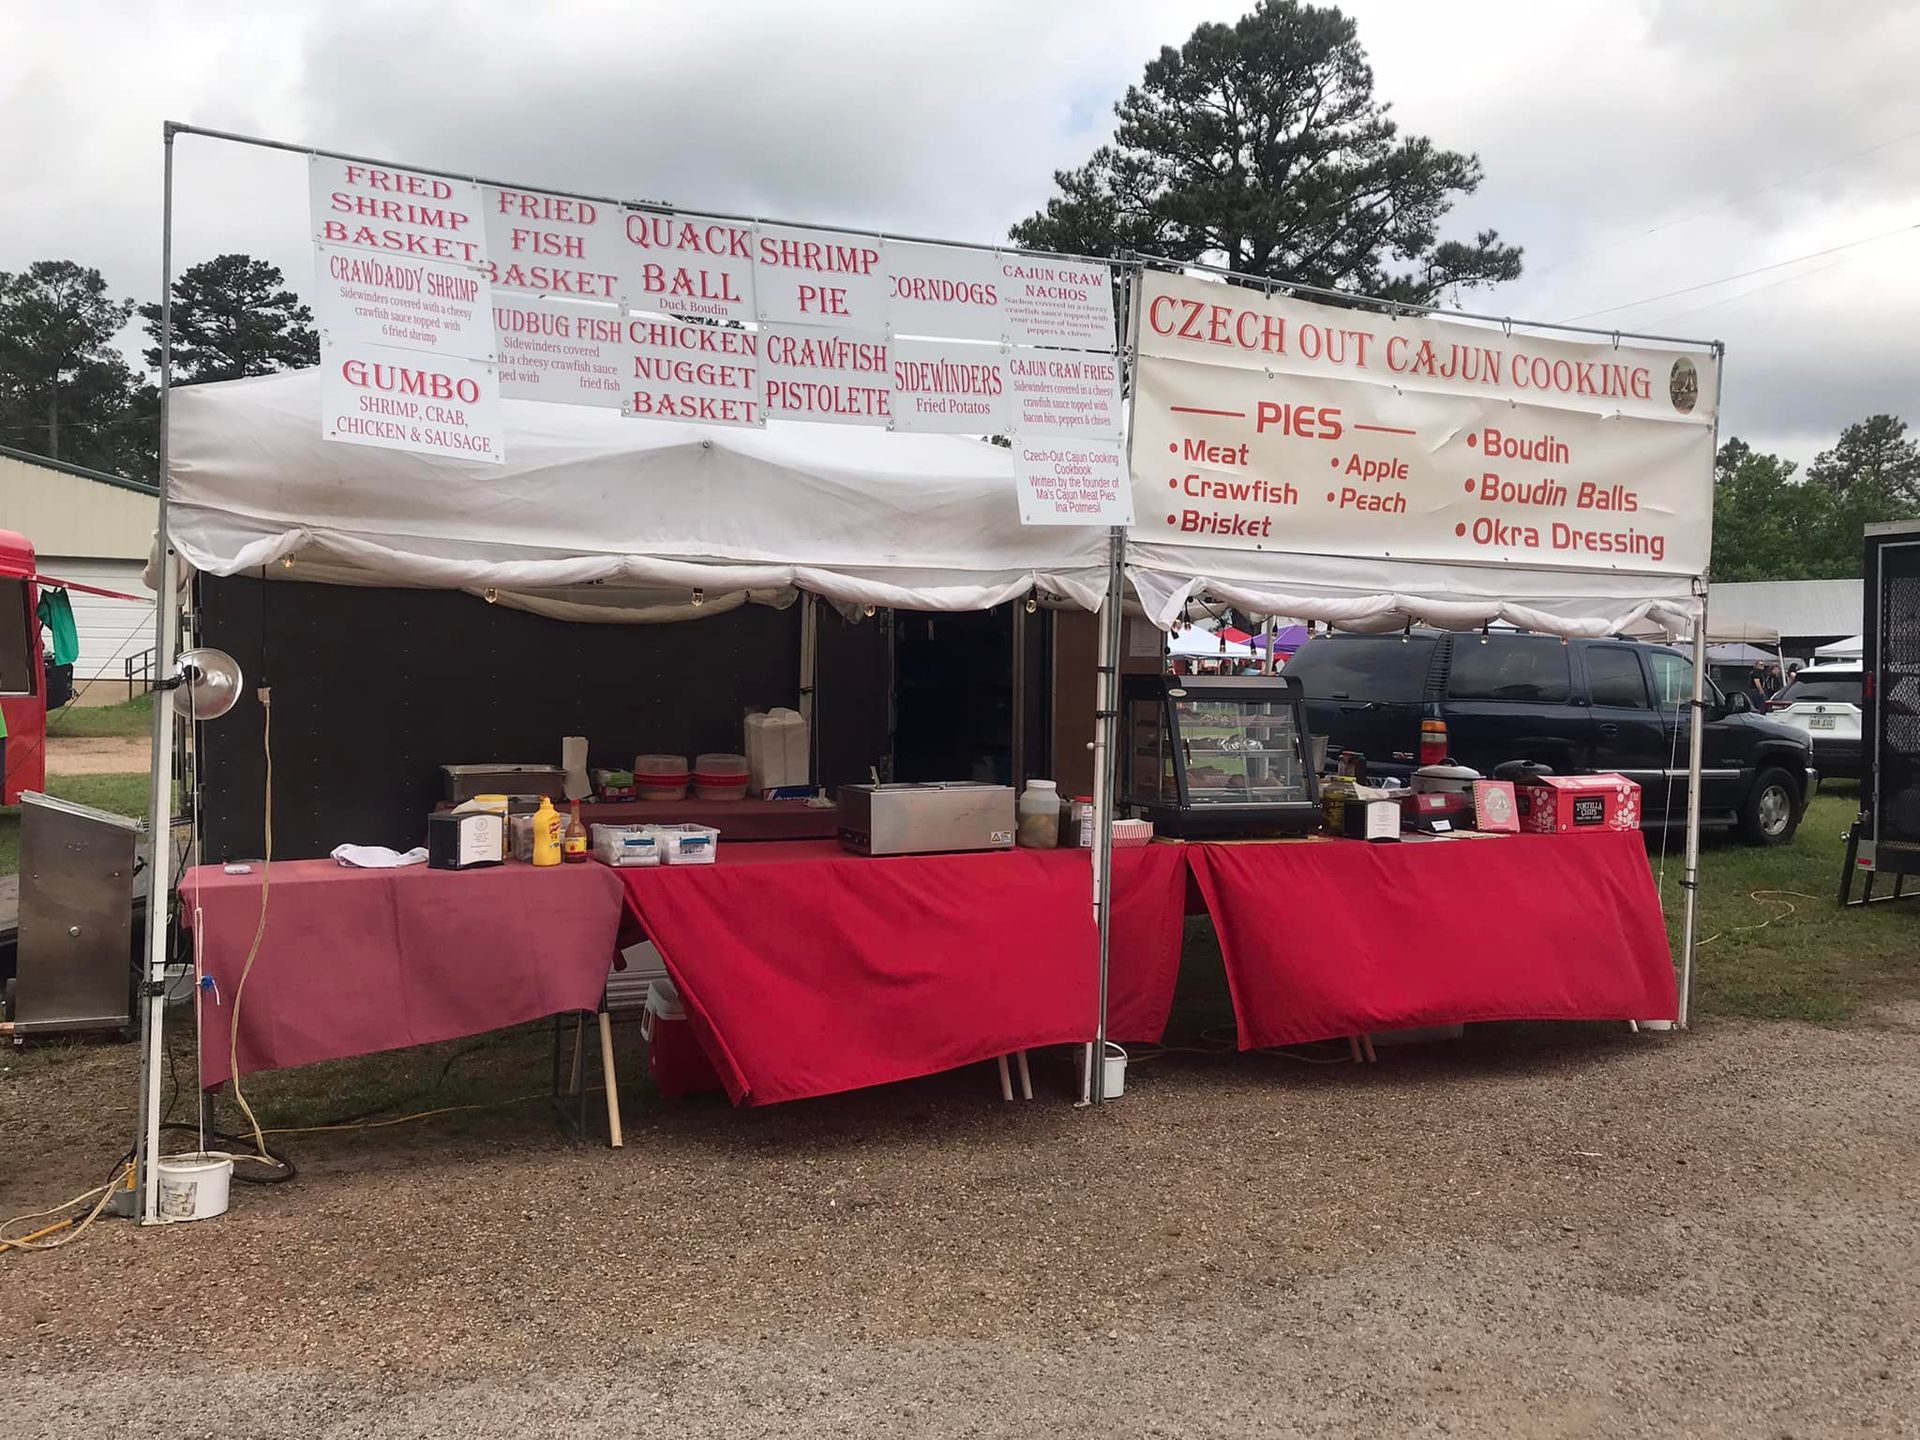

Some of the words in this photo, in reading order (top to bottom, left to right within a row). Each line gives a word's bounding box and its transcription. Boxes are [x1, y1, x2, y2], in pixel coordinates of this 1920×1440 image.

[346, 165, 453, 200] FRIED
[331, 192, 469, 230] SHRIMP
[498, 191, 596, 225] FRIED
[323, 221, 479, 262] BASKET
[511, 228, 585, 259] FISH
[626, 214, 752, 260] QUACK
[760, 237, 879, 276] SHRIMP
[330, 255, 423, 292] CRAWDADDY
[428, 272, 478, 302] SHRIMP
[642, 264, 742, 302] BALL
[1003, 265, 1054, 281] CAJUN
[1059, 271, 1103, 286] CRAW
[340, 287, 388, 304] Sidewinders
[390, 297, 421, 310] covered
[422, 301, 439, 313] with
[447, 304, 472, 320] cheesy
[660, 298, 686, 310] Duck
[690, 300, 728, 315] Boudin
[798, 284, 850, 317] PIE
[1026, 285, 1087, 301] NACHOS
[355, 306, 388, 320] crawfish
[390, 311, 412, 323] sauce
[413, 315, 440, 329] topped
[444, 319, 460, 332] with
[382, 324, 387, 336] 6
[389, 326, 408, 338] fried
[409, 329, 436, 345] shrimp
[492, 308, 570, 338] UDBUG
[577, 317, 622, 344] FISH
[504, 336, 561, 352] Sidewinders
[564, 344, 600, 357] covered
[629, 321, 758, 356] CHICKEN
[767, 335, 888, 373] CRAWFISH
[1149, 295, 1288, 356] CZECH
[1300, 323, 1375, 369] OUT
[1386, 335, 1502, 386] CAJUN
[1511, 353, 1652, 400] COOKING
[510, 356, 515, 364] a
[517, 355, 548, 370] cheesy
[551, 359, 590, 372] crawfish
[593, 365, 618, 375] sauce
[519, 370, 540, 383] with
[580, 376, 601, 389] fried
[604, 378, 620, 391] fish
[634, 356, 756, 388] NUGGET
[895, 358, 1002, 396] SIDEWINDERS
[1010, 360, 1046, 376] CAJUN
[1049, 361, 1081, 379] CRAW
[1084, 364, 1115, 381] FRIES
[342, 360, 481, 404] GUMBO
[1013, 380, 1053, 392] Sidewinders
[1054, 384, 1079, 394] covered
[1093, 385, 1113, 399] cheesy
[360, 395, 422, 422] SHRIMP,
[426, 405, 468, 428] CRAB,
[633, 391, 757, 422] BASKET
[766, 380, 891, 417] PISTOLETE
[917, 398, 946, 413] Fried
[950, 398, 990, 414] Potatos
[1024, 397, 1051, 408] crawfish
[1053, 400, 1070, 409] sauce
[1071, 401, 1092, 412] topped
[1094, 401, 1108, 411] with
[337, 416, 406, 440] CHICKEN
[410, 426, 421, 443] &
[425, 429, 492, 452] SAUSAGE
[1023, 411, 1043, 422] bacon
[1059, 415, 1083, 427] peppers
[1256, 401, 1343, 440] PIES
[1023, 449, 1065, 462] Czech-Out
[1066, 451, 1087, 465] Cajun
[1089, 452, 1119, 467] Cooking
[1184, 438, 1249, 466] Meat
[1483, 428, 1569, 464] Boudin
[1029, 475, 1056, 487] Written
[1059, 476, 1067, 489] by
[1069, 476, 1081, 487] the
[1082, 477, 1110, 488] founder
[1112, 477, 1119, 488] of
[1055, 463, 1092, 475] Cookbook
[1345, 453, 1409, 482] Apple
[1036, 489, 1054, 500] Ma's
[1056, 489, 1078, 502] Cajun
[1080, 489, 1098, 500] Meat
[1100, 489, 1116, 501] Pies
[1183, 474, 1298, 505] Crawfish
[1339, 487, 1407, 513] Peach
[1480, 473, 1568, 507] Boudin
[1577, 481, 1638, 513] Balls
[1056, 501, 1068, 512] Ina
[1069, 501, 1101, 513] Potmesil
[1180, 509, 1272, 537] Brisket
[1472, 517, 1540, 548] Okra
[1552, 522, 1665, 561] Dressing
